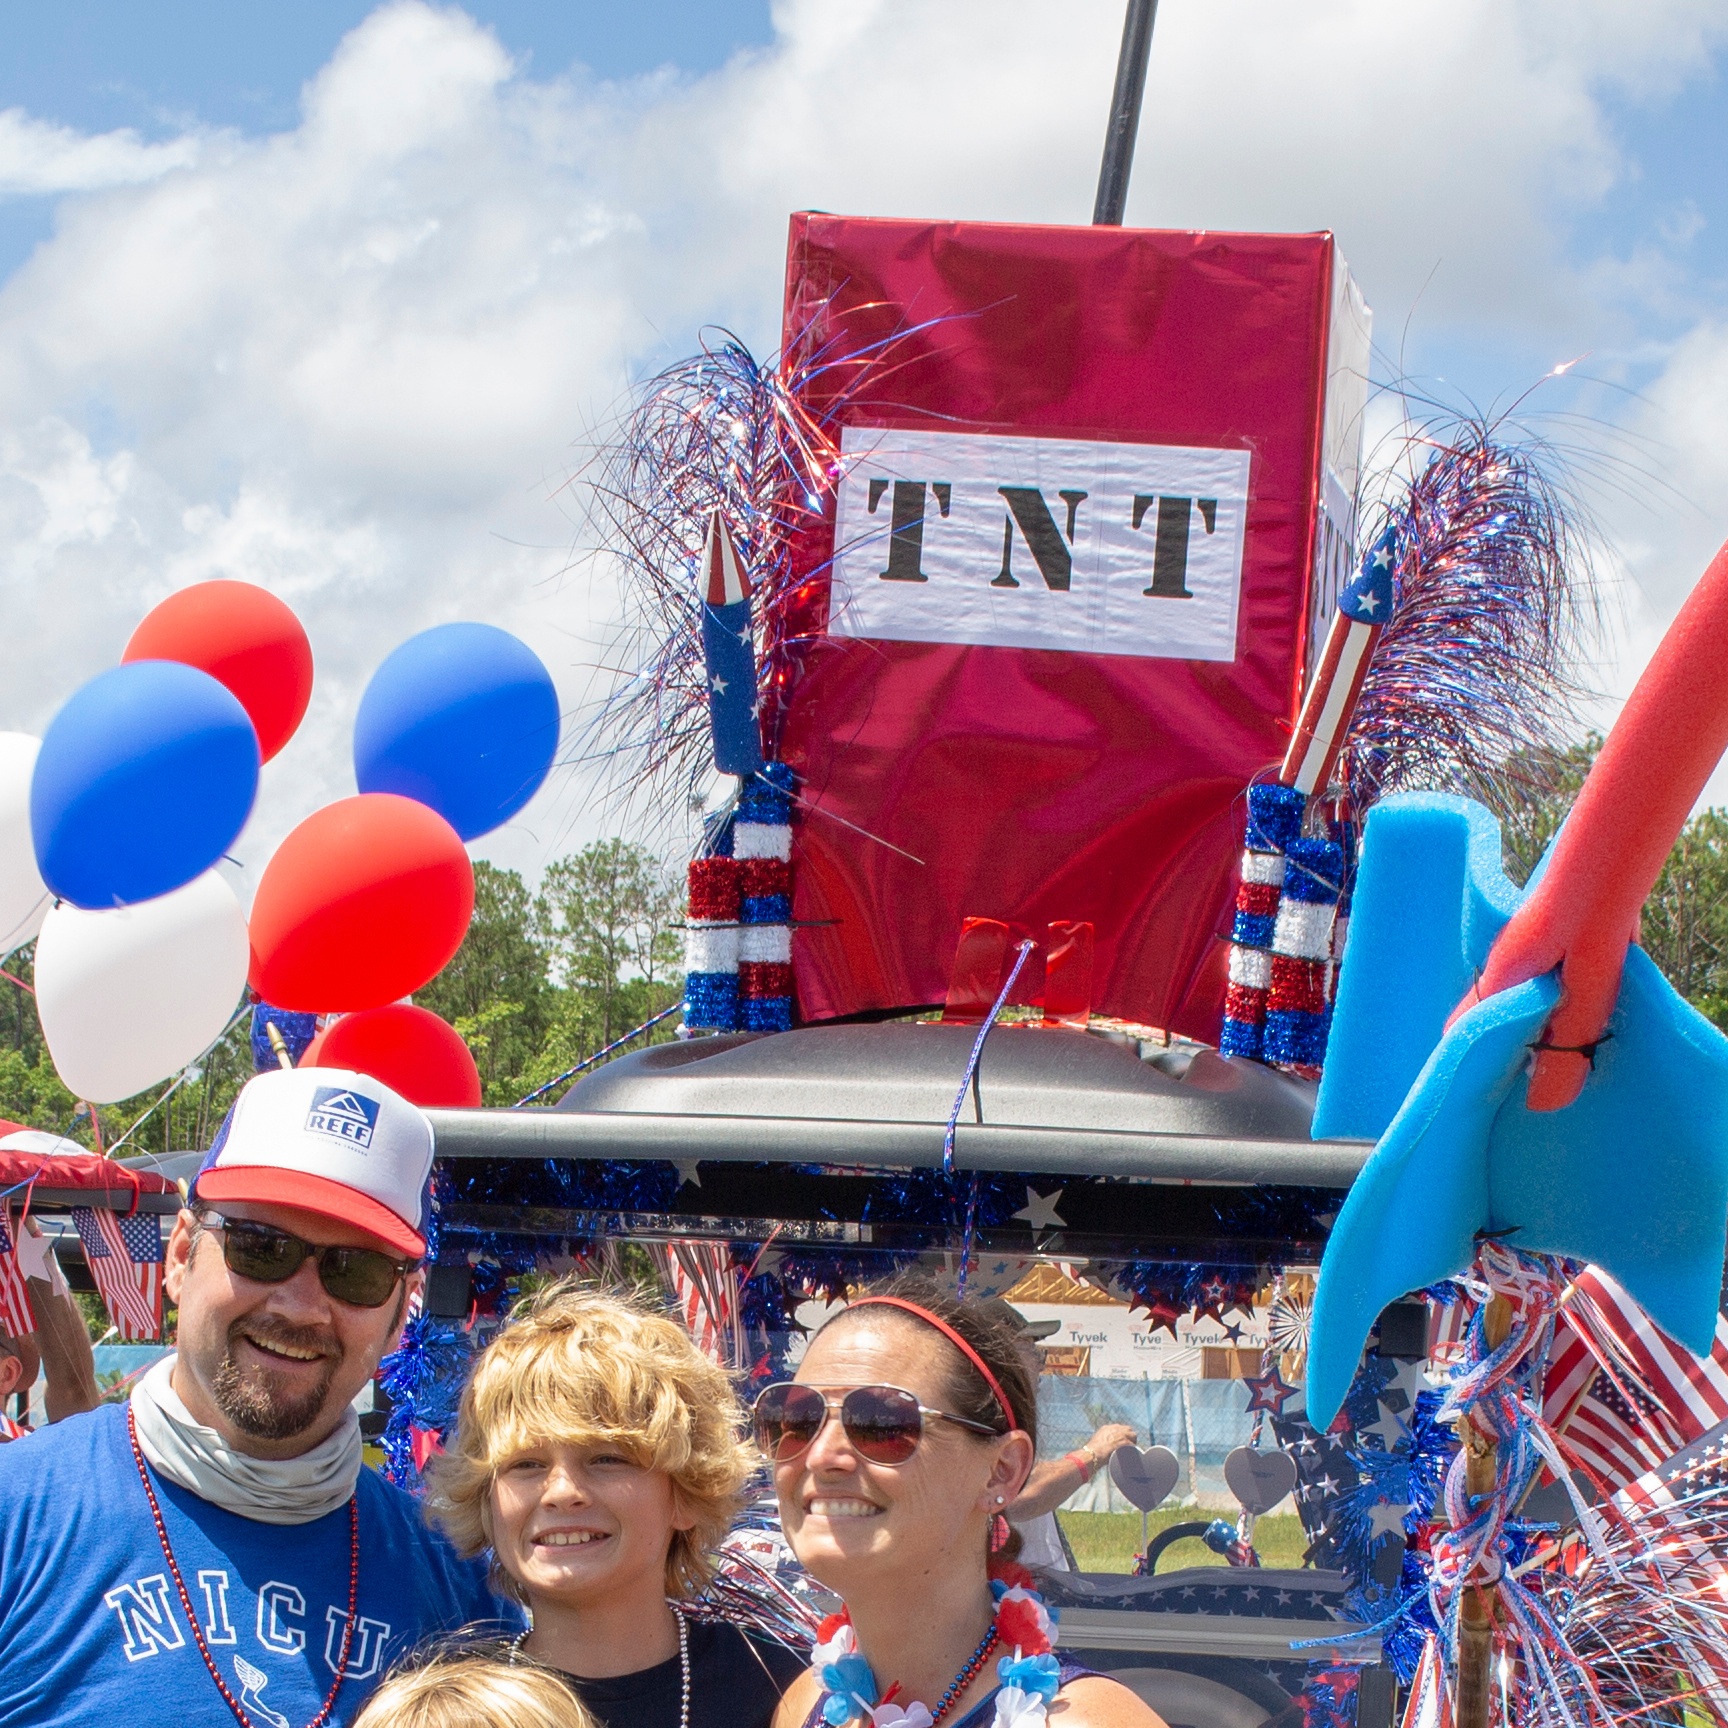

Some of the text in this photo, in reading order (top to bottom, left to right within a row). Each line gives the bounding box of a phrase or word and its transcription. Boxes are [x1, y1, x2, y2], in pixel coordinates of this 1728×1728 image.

[867, 479, 1218, 600] TNT
[309, 1115, 369, 1142] REEF
[1069, 1330, 1108, 1345] Tyvek
[104, 1569, 391, 1680] NICU
